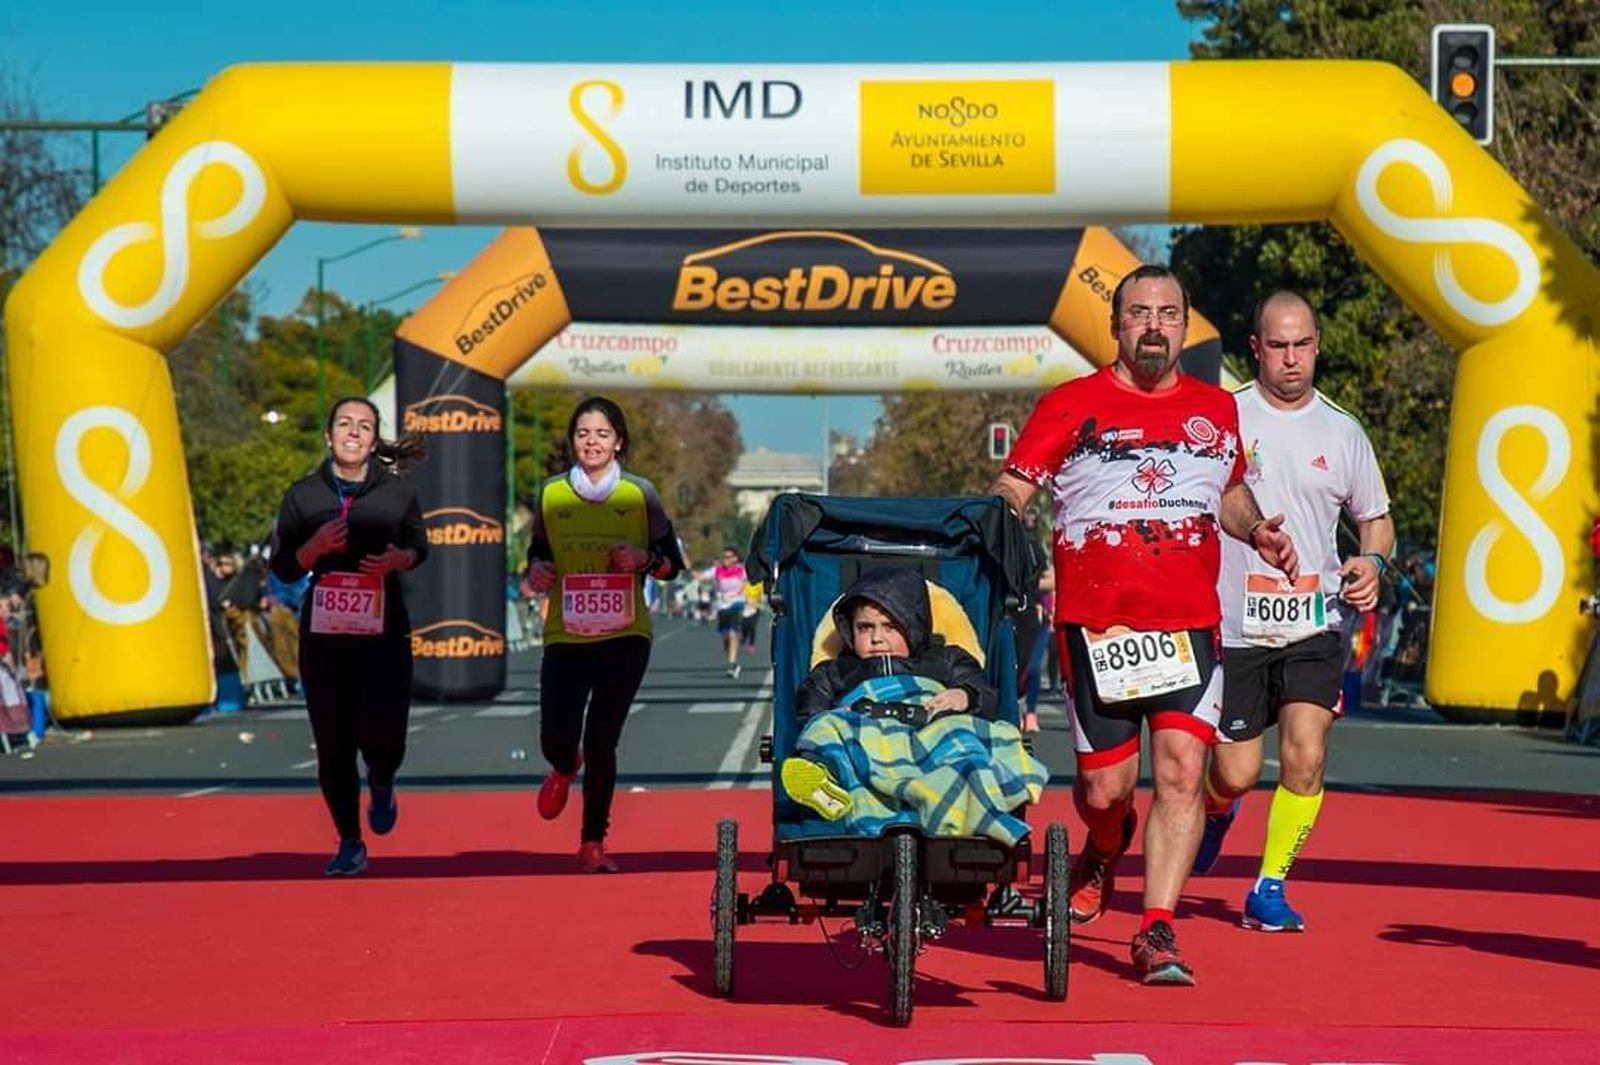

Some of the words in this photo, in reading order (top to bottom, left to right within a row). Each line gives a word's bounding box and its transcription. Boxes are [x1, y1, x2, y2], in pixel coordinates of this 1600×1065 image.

[684, 80, 803, 119] IMD
[656, 153, 732, 170] Instituto
[738, 153, 829, 173] Municipal
[911, 153, 933, 168] DE
[938, 150, 1005, 168] SEVILLA
[685, 178, 709, 193] de
[715, 178, 801, 196] Deportes
[672, 264, 957, 311] BestDrive
[455, 273, 547, 356] BestDrive
[557, 330, 678, 355] Cruzcampo
[932, 333, 1053, 355] Cruzcampo
[324, 591, 374, 613] 8527
[574, 593, 623, 614] 8558
[1258, 596, 1311, 622] 6081
[1106, 631, 1177, 670] 8906
